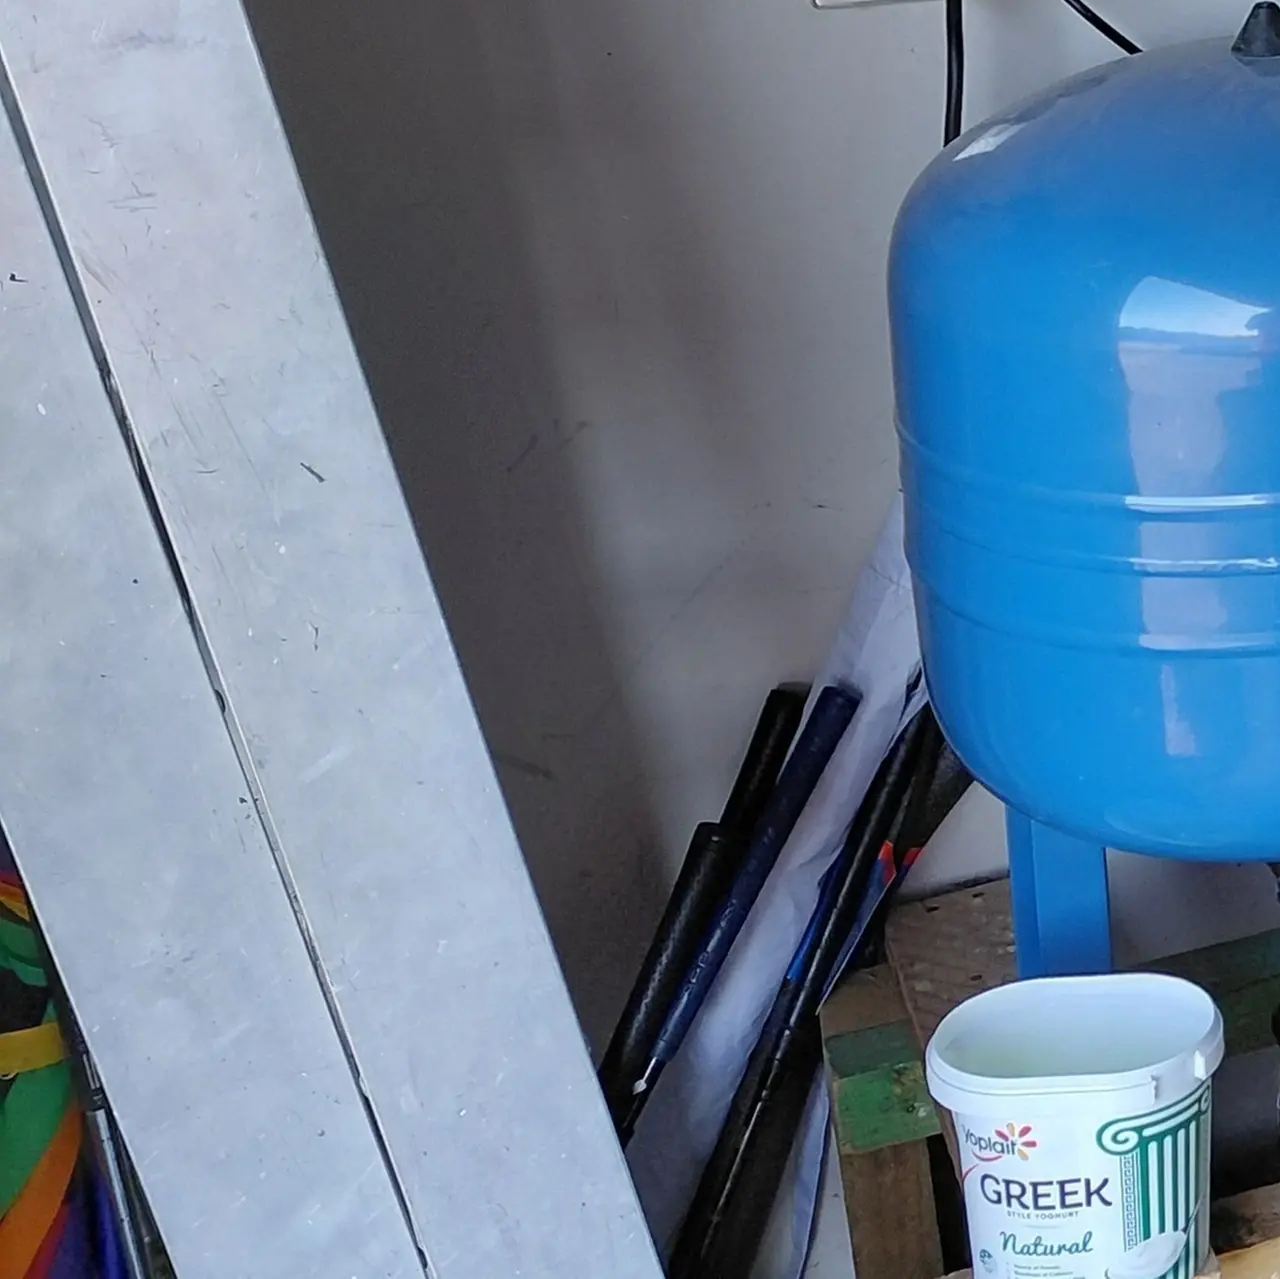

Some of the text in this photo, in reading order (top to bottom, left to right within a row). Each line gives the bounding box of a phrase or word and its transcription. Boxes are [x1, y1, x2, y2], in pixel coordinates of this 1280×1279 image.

[962, 1123, 1018, 1156] Yoplait
[980, 1173, 1113, 1211] GREEK
[1006, 1210, 1079, 1221] STYLE YOGHURT
[999, 1230, 1094, 1257] Natural
